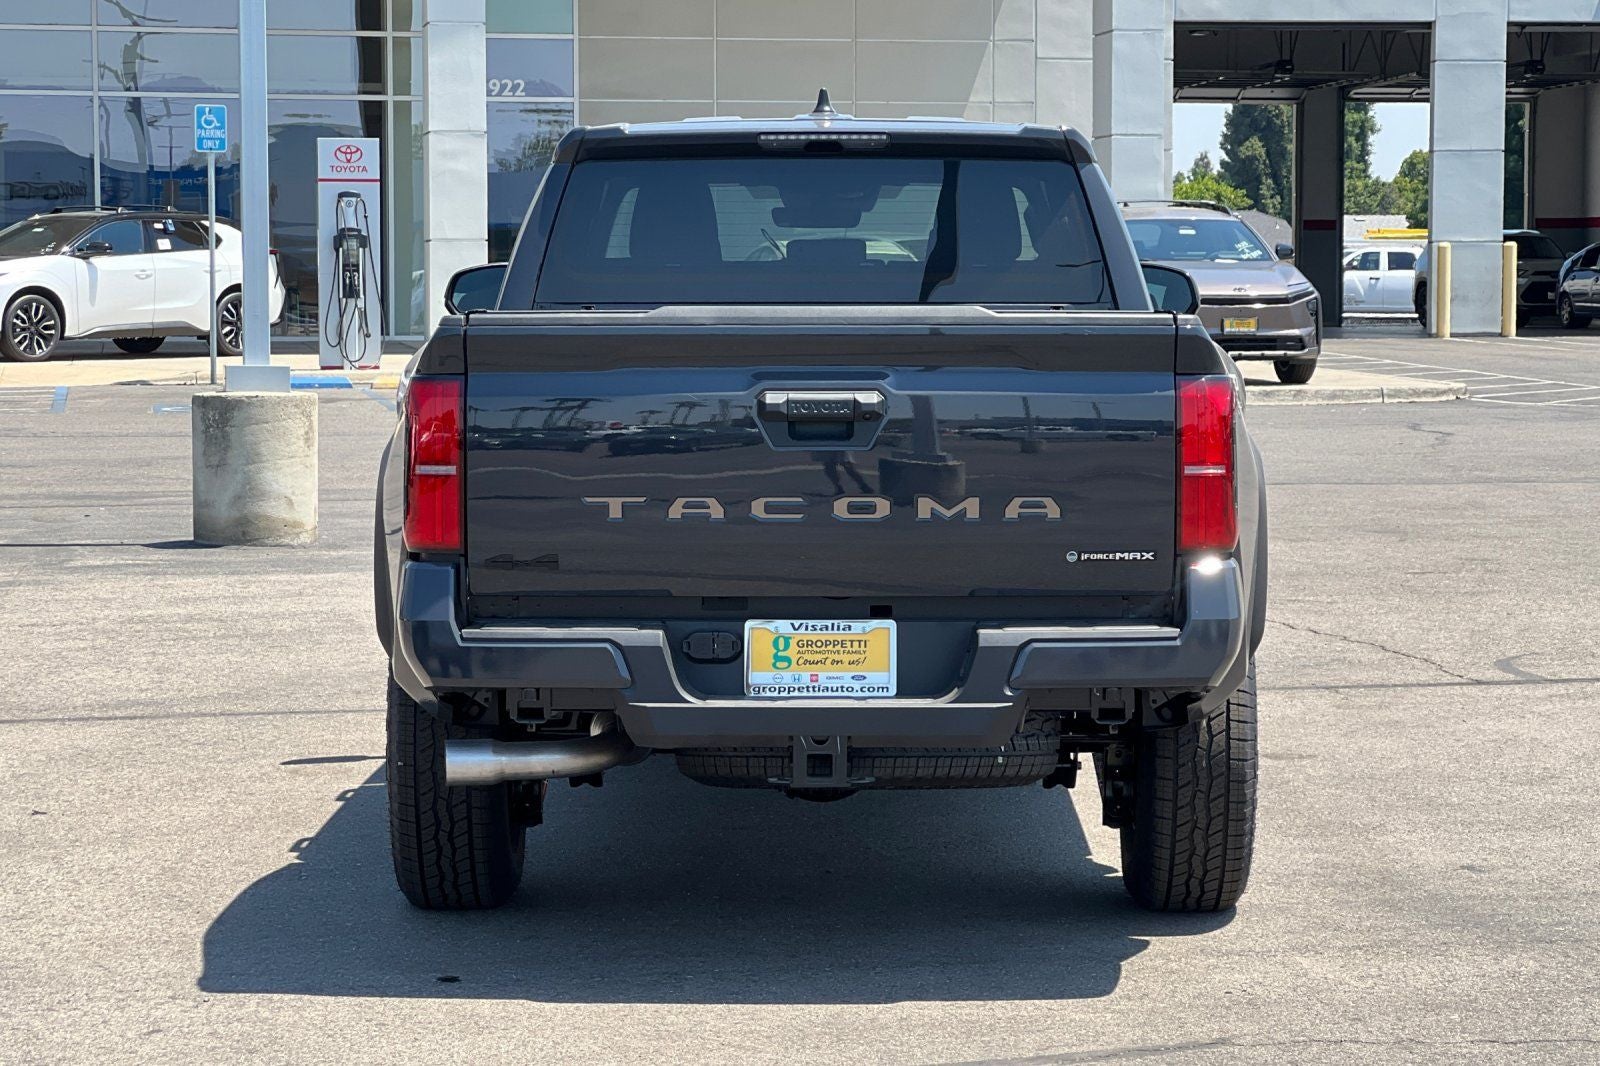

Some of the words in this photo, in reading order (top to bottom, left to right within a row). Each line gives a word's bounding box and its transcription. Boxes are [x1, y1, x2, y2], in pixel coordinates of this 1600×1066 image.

[488, 79, 526, 96] 922
[197, 128, 225, 138] PARKING
[203, 139, 220, 149] ONLY
[329, 165, 368, 173] TOYOTA
[791, 403, 850, 413] TOYOTA
[582, 496, 1063, 522] TACOMA
[790, 622, 852, 632] Visalia
[796, 639, 867, 649] GROPPETTI
[796, 656, 828, 666] Count
[848, 656, 867, 666] us!
[752, 684, 889, 695] groppettiauto.com
